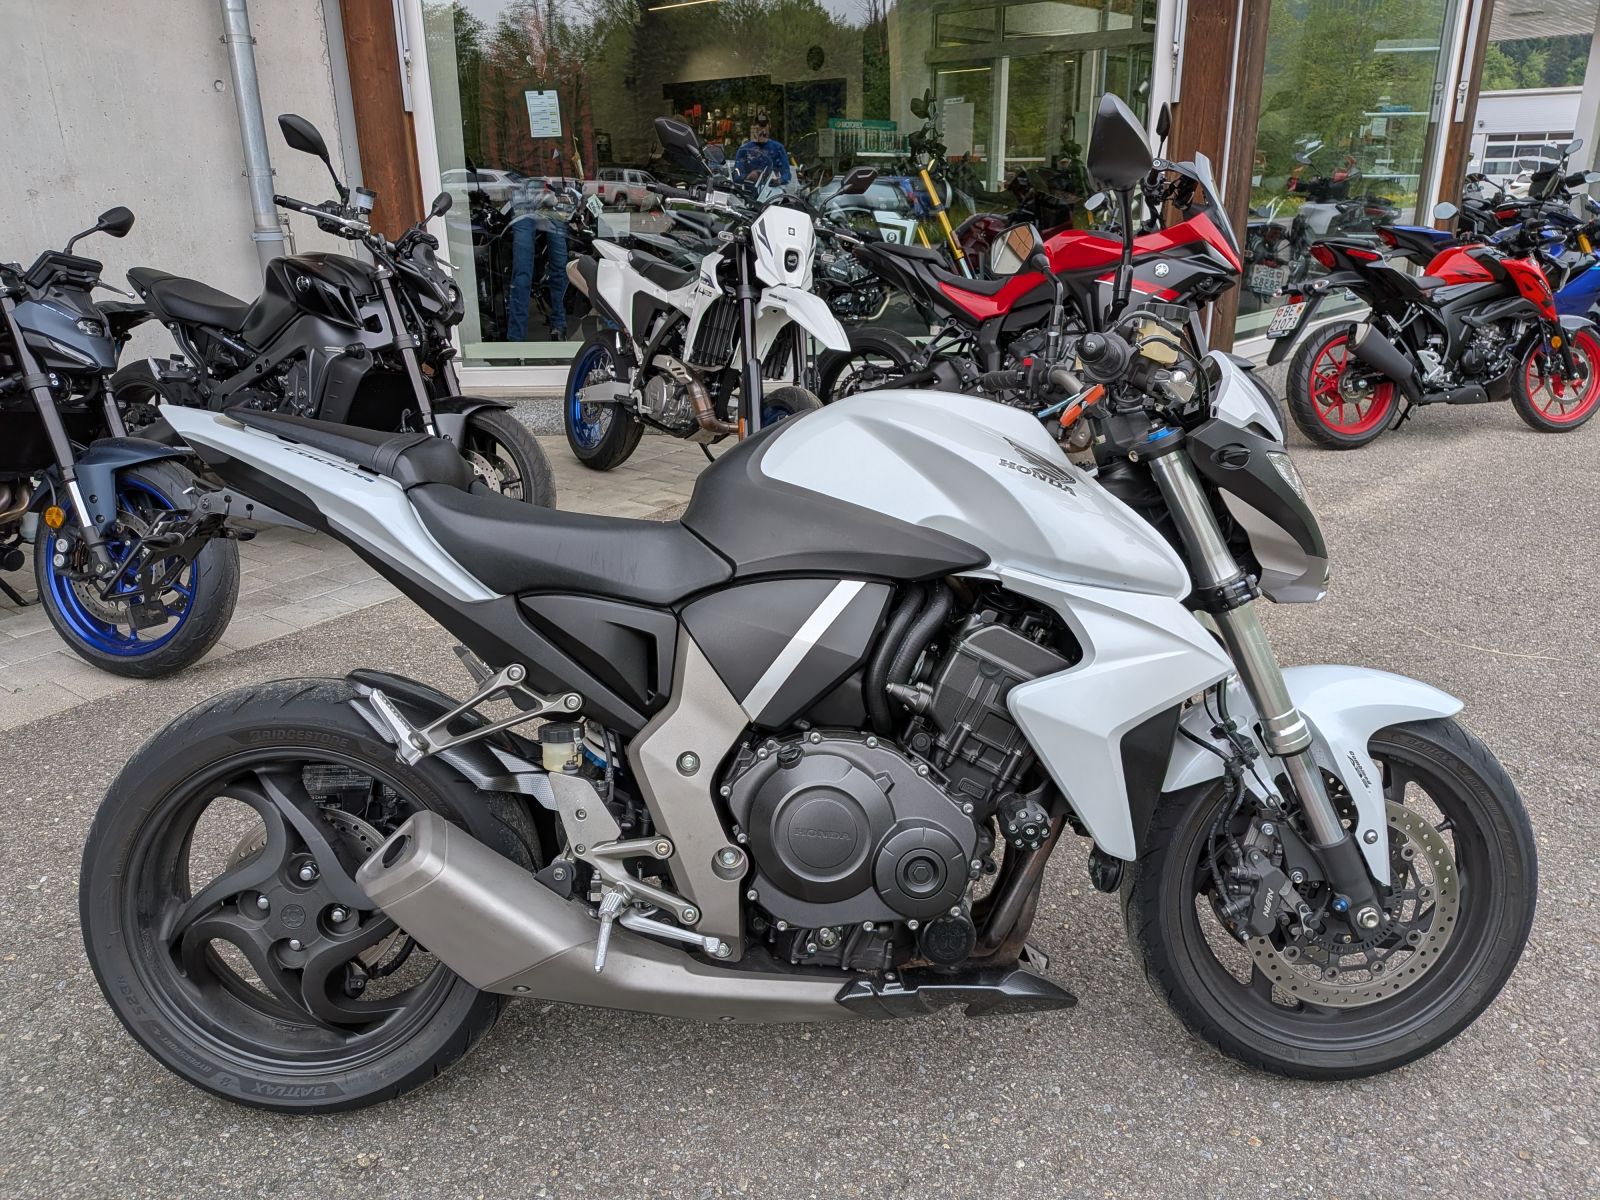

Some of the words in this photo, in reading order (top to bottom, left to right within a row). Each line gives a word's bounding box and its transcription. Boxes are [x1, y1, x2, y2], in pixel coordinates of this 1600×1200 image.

[1283, 305, 1297, 317] BE
[1270, 317, 1297, 331] 21073
[999, 458, 1077, 497] HONDA
[249, 729, 350, 748] BRIDGESTONE
[792, 827, 853, 841] HONDA
[1262, 887, 1275, 918] NISSIN
[250, 1081, 329, 1098] BATTLAX
